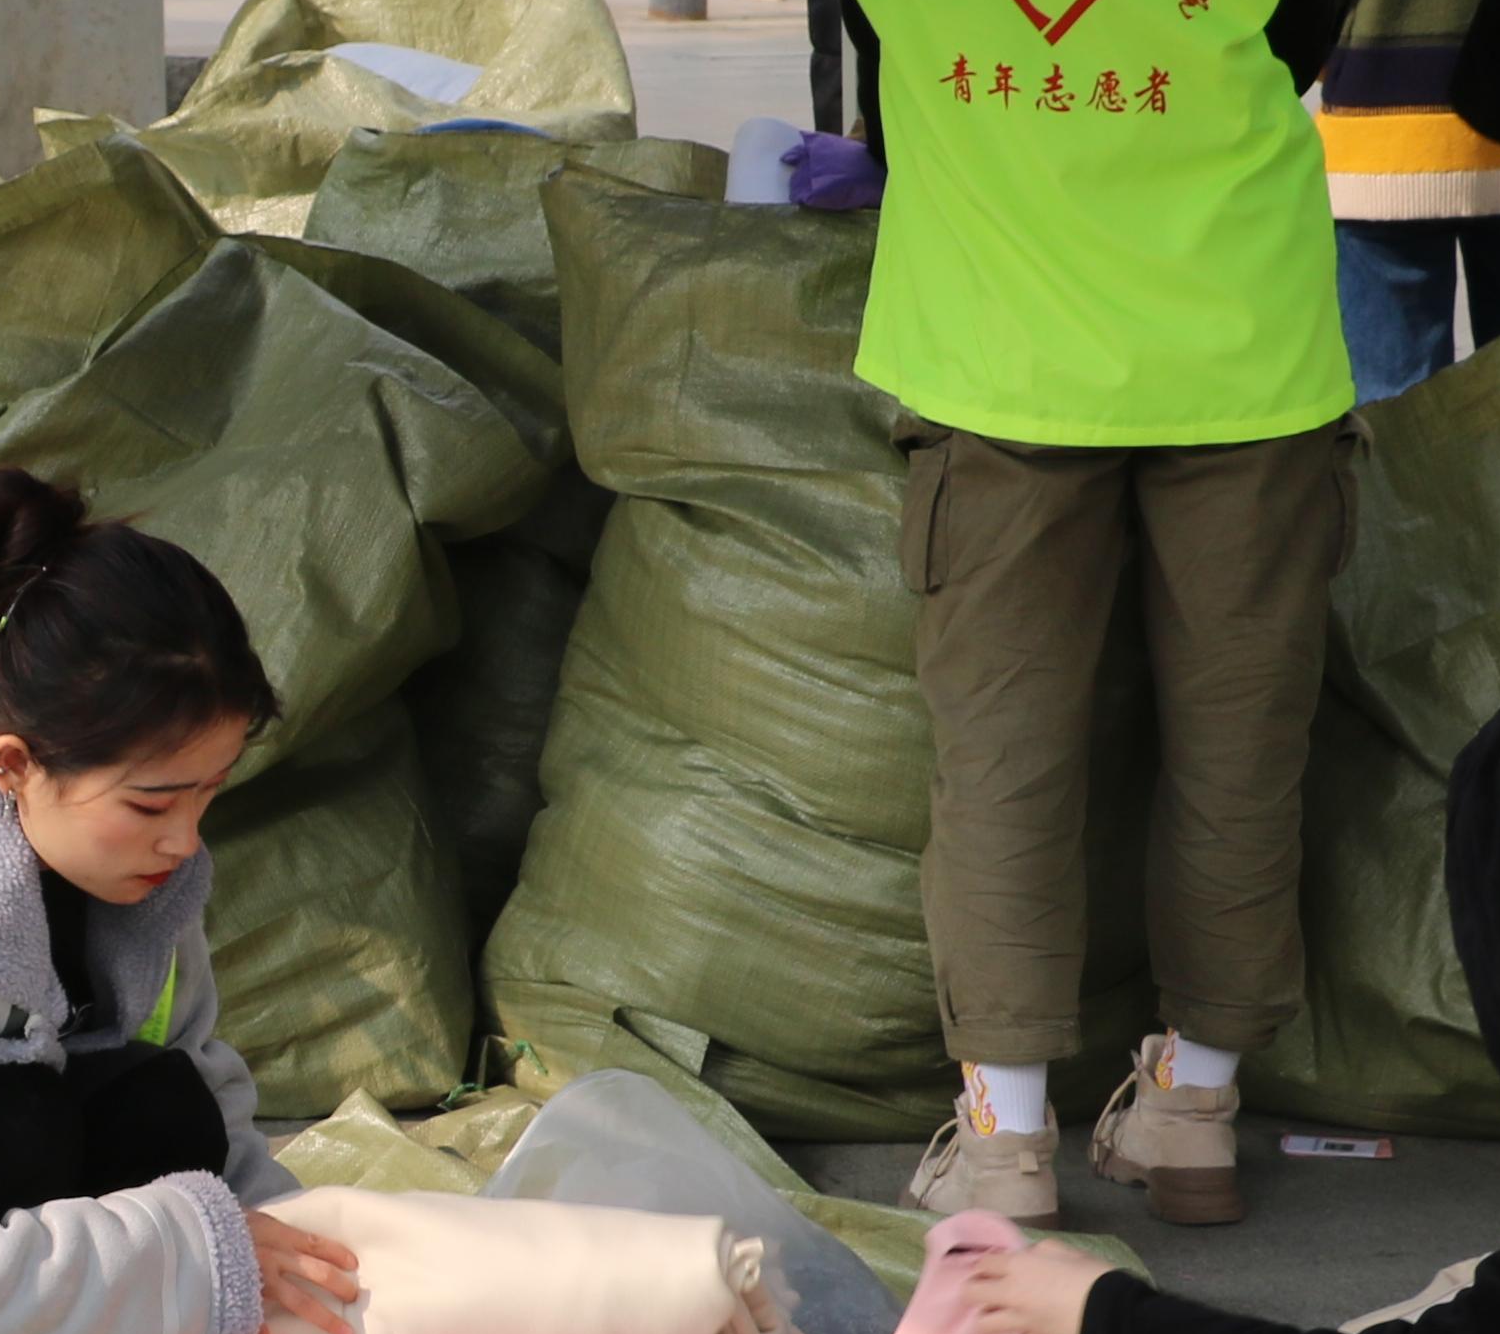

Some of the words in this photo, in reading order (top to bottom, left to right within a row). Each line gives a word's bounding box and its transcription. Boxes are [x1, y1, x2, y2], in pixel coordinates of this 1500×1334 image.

[938, 53, 1172, 116] 青年志愿者
